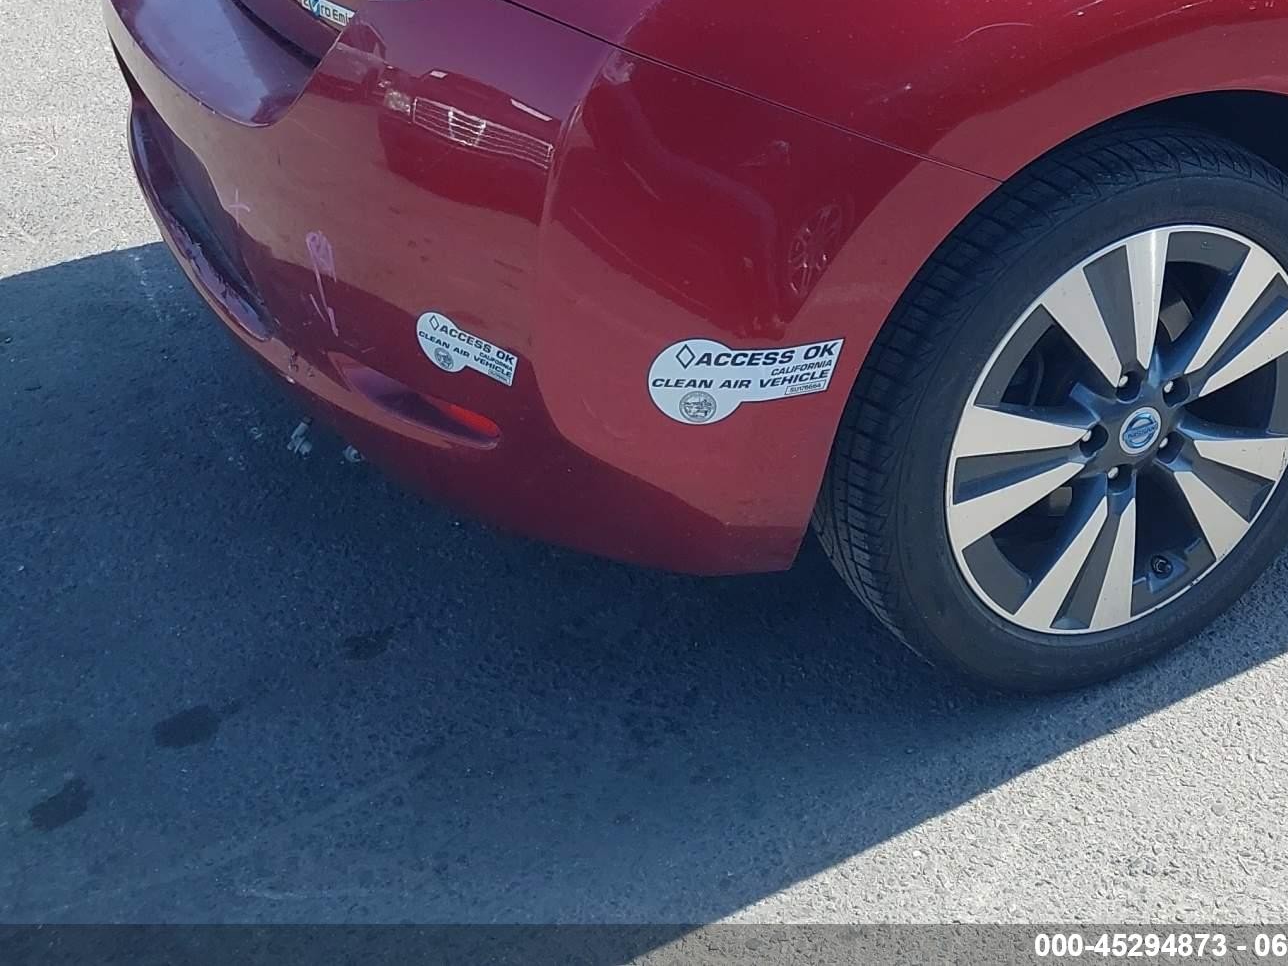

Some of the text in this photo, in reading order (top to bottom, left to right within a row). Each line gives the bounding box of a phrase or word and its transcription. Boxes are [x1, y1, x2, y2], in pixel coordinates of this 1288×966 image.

[418, 330, 451, 349] CLEAN
[453, 346, 470, 357] AIR
[473, 355, 513, 377] VEHICLE
[440, 325, 515, 365] ACCESS OK
[694, 342, 840, 366] ACCESS OK
[479, 352, 513, 372] CALIFORNIA
[770, 359, 832, 376] CALIFORNIA
[651, 369, 831, 389] CLEAN AIR VEHICLE
